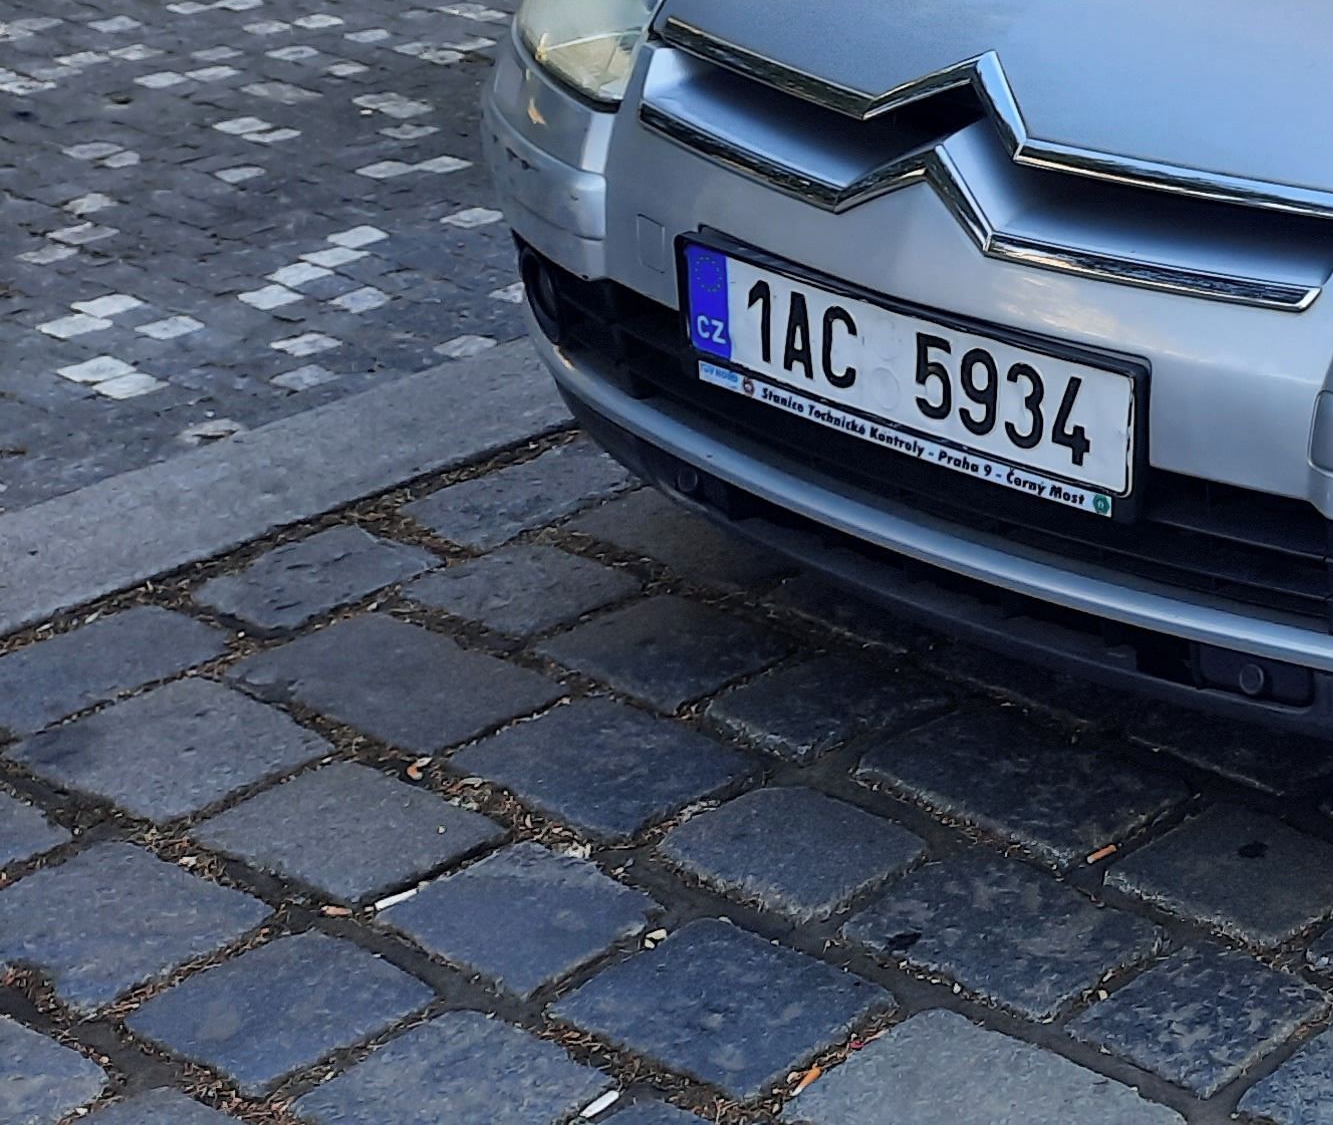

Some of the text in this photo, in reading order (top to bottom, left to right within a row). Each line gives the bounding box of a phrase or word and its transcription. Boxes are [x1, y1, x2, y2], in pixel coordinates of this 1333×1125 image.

[697, 315, 727, 345] CZ
[747, 280, 1091, 466] 1AC 5934
[870, 426, 925, 458] Kontroly
[938, 450, 980, 473] Praha
[983, 464, 993, 477] 9
[1006, 466, 1046, 496] Černý
[1049, 484, 1085, 505] Most
